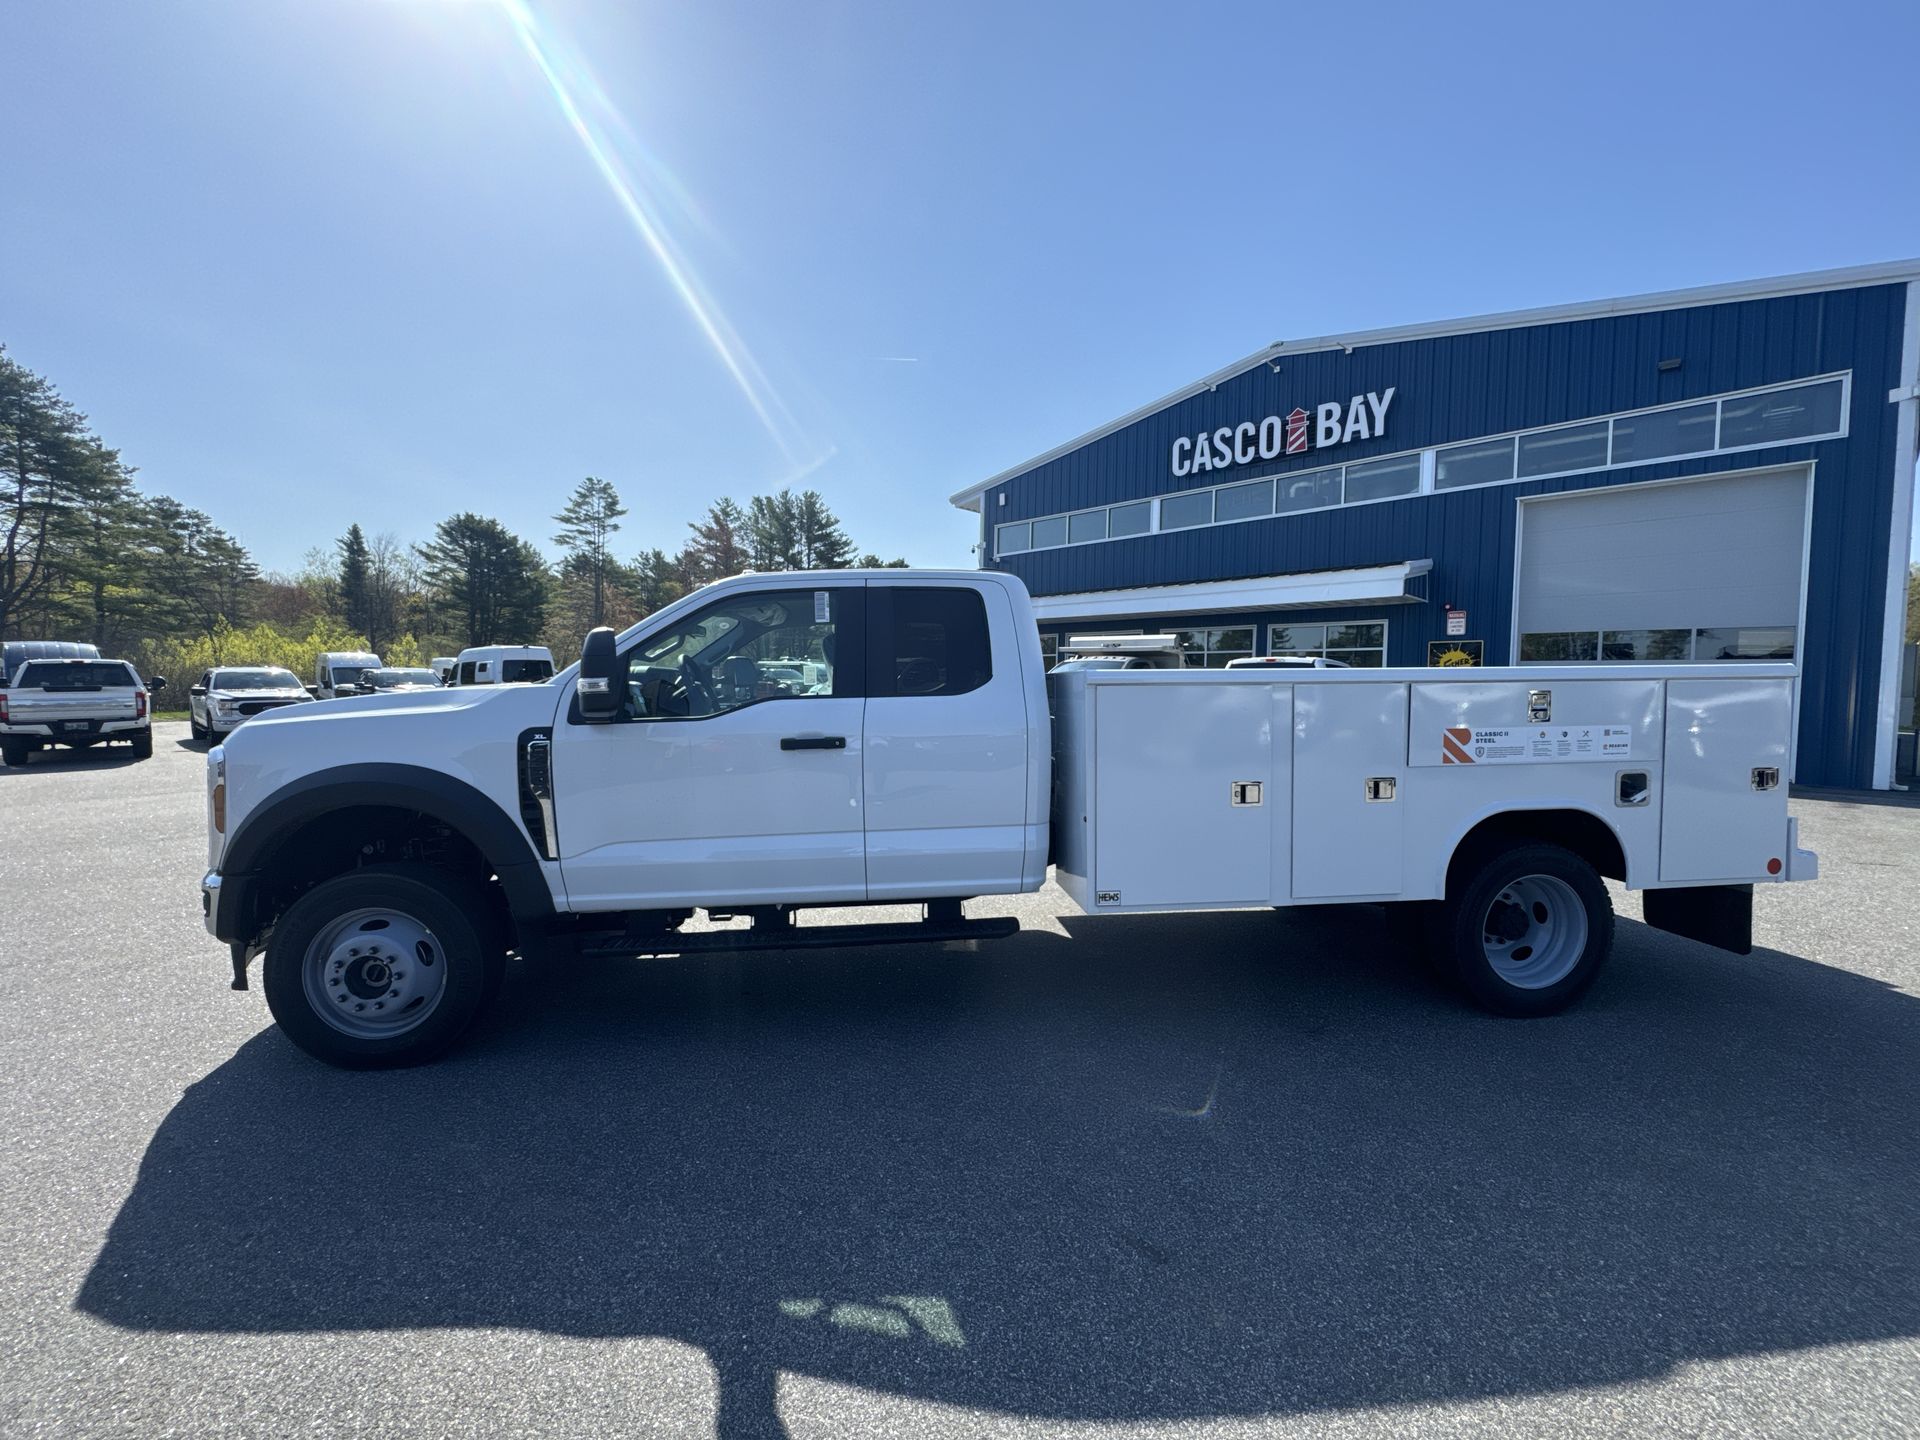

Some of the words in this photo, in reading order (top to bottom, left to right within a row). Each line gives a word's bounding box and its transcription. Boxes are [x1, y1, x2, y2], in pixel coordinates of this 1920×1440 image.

[1172, 415, 1282, 477] CASCO
[1316, 386, 1396, 449] BAY
[1098, 893, 1120, 904] HEWS
